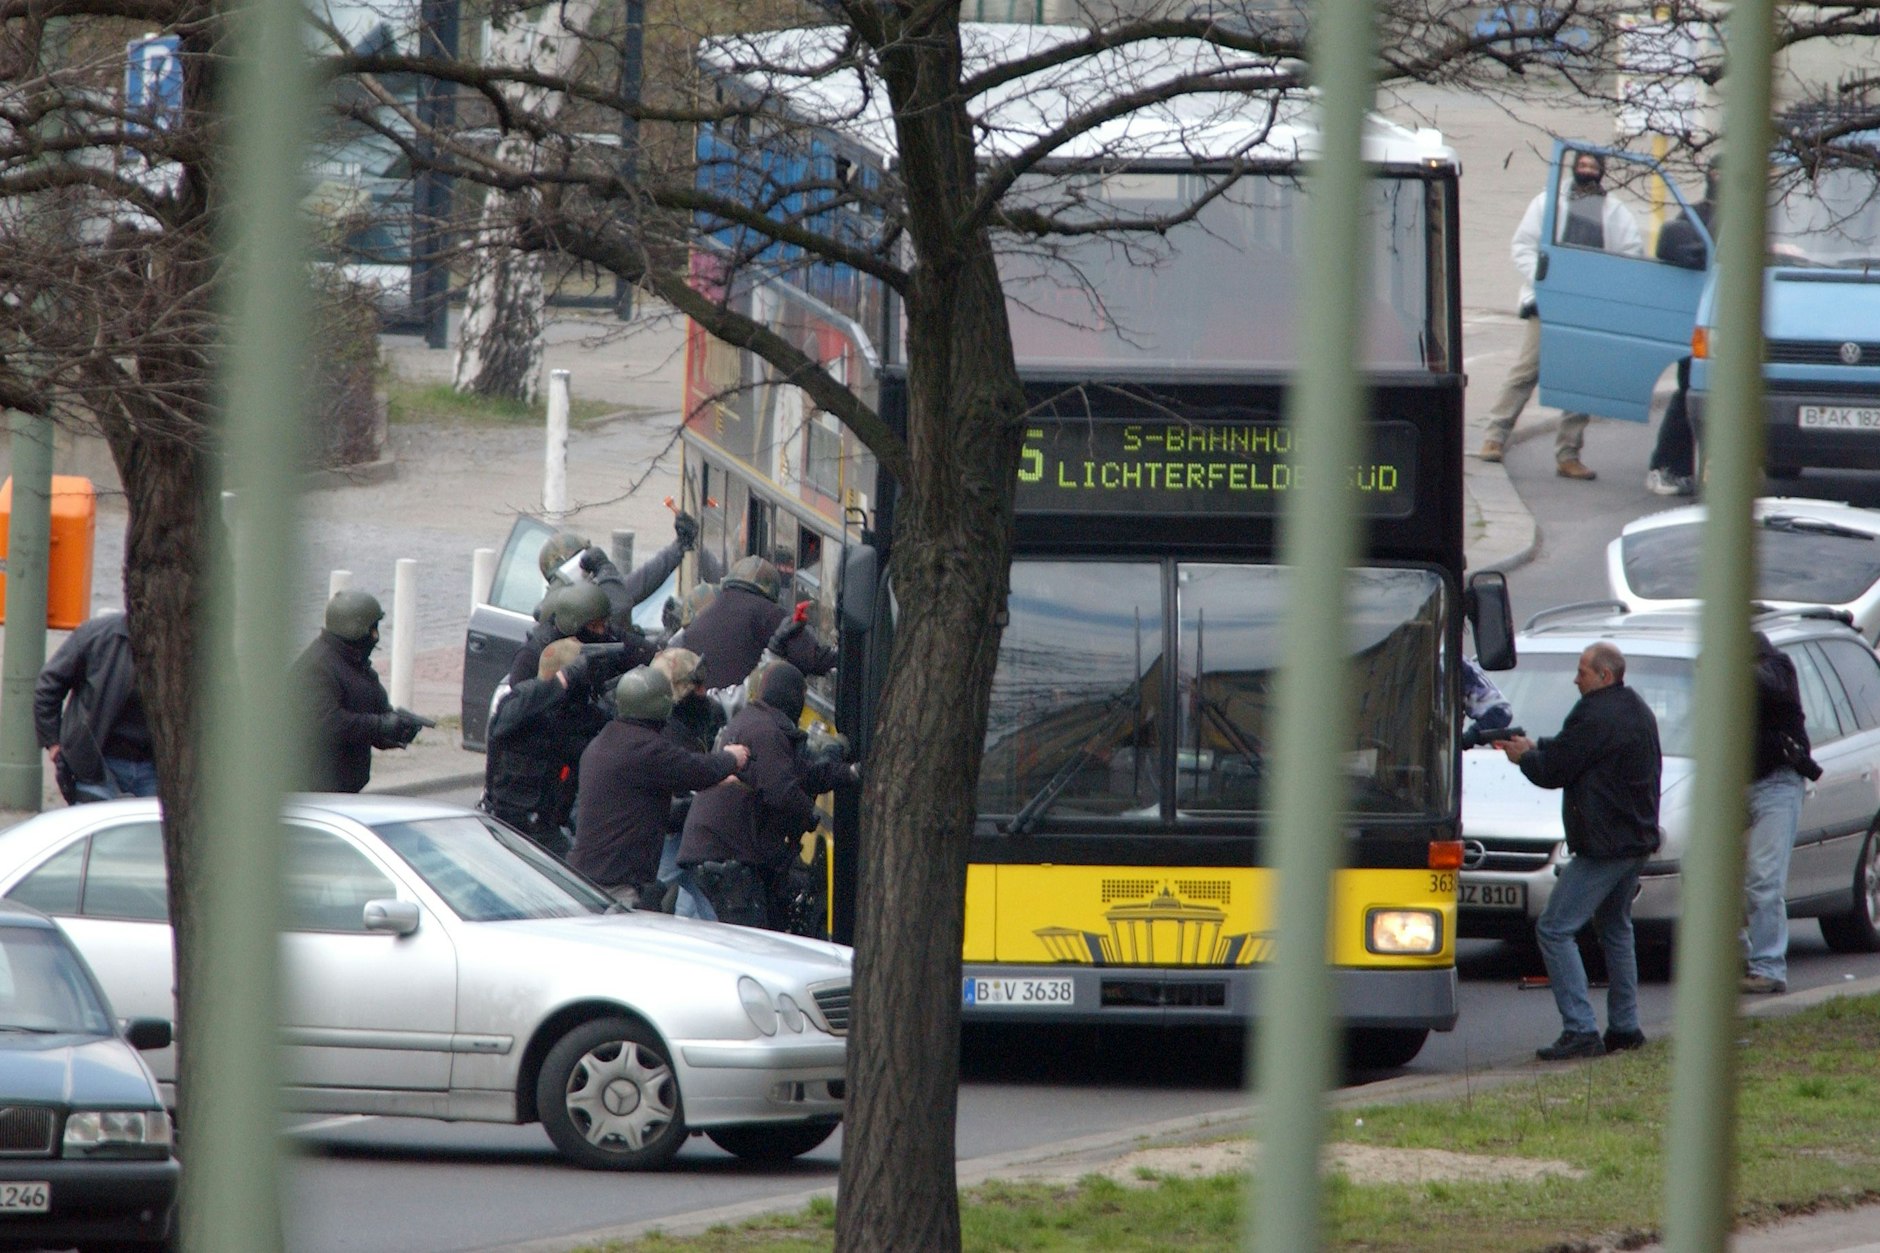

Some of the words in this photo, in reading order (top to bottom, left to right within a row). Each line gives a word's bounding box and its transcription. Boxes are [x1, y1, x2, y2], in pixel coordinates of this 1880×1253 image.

[143, 44, 173, 105] P
[1806, 409, 1818, 424] B
[1827, 409, 1851, 425] AK
[1124, 426, 1303, 452] S-BAHNHO
[1349, 465, 1397, 490] ÜD
[1429, 874, 1456, 892] 363
[1482, 885, 1516, 904] 810
[977, 982, 989, 1001] B
[1004, 982, 1016, 1001] V
[1022, 982, 1071, 1001] 3638
